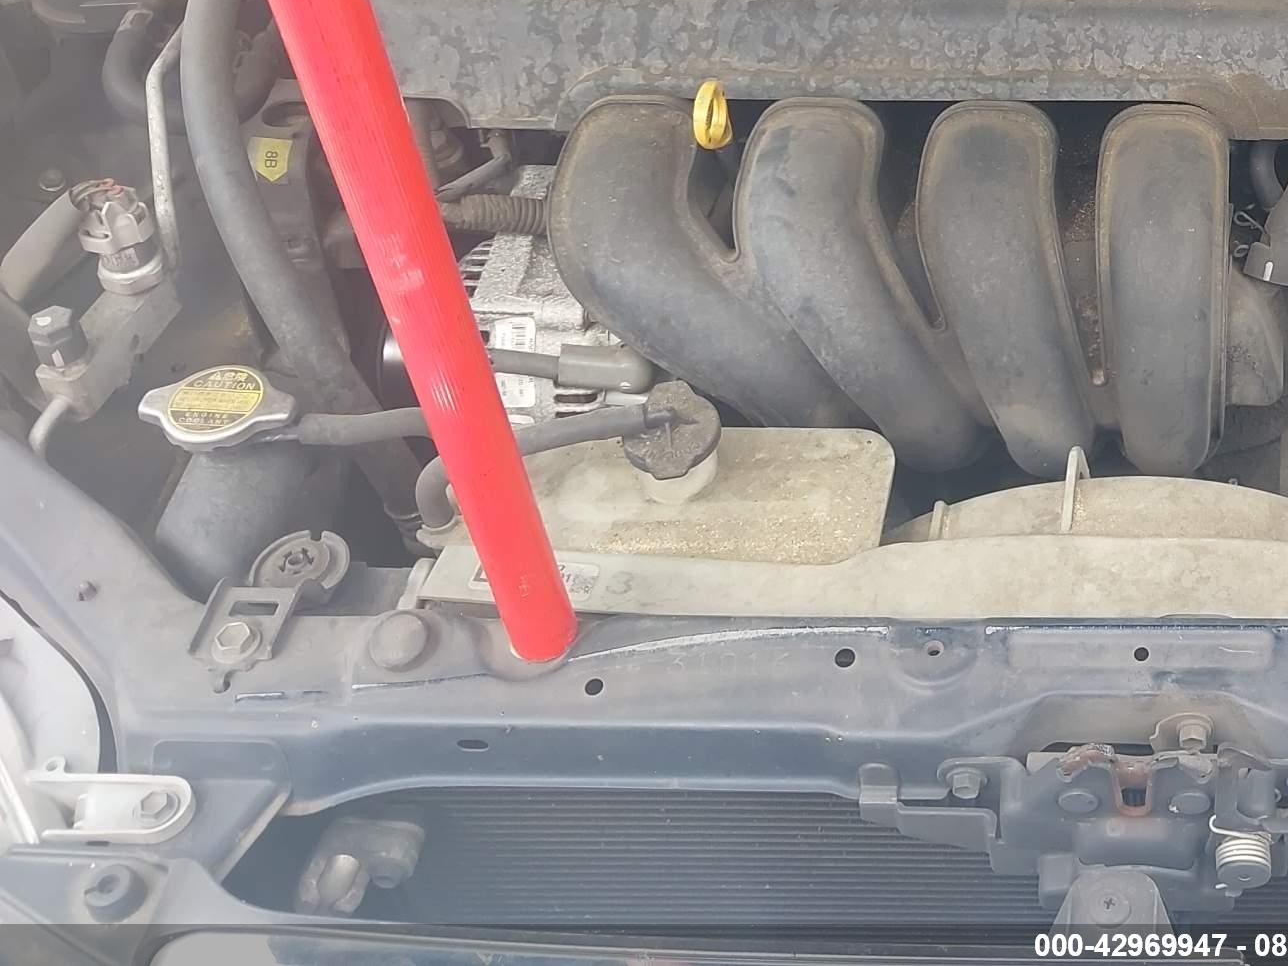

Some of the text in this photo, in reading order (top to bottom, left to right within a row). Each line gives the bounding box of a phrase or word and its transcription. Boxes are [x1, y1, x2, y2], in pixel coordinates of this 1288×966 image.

[193, 379, 256, 390] CAUTION
[184, 411, 230, 419] ENGINE
[178, 417, 230, 425] COOLANT
